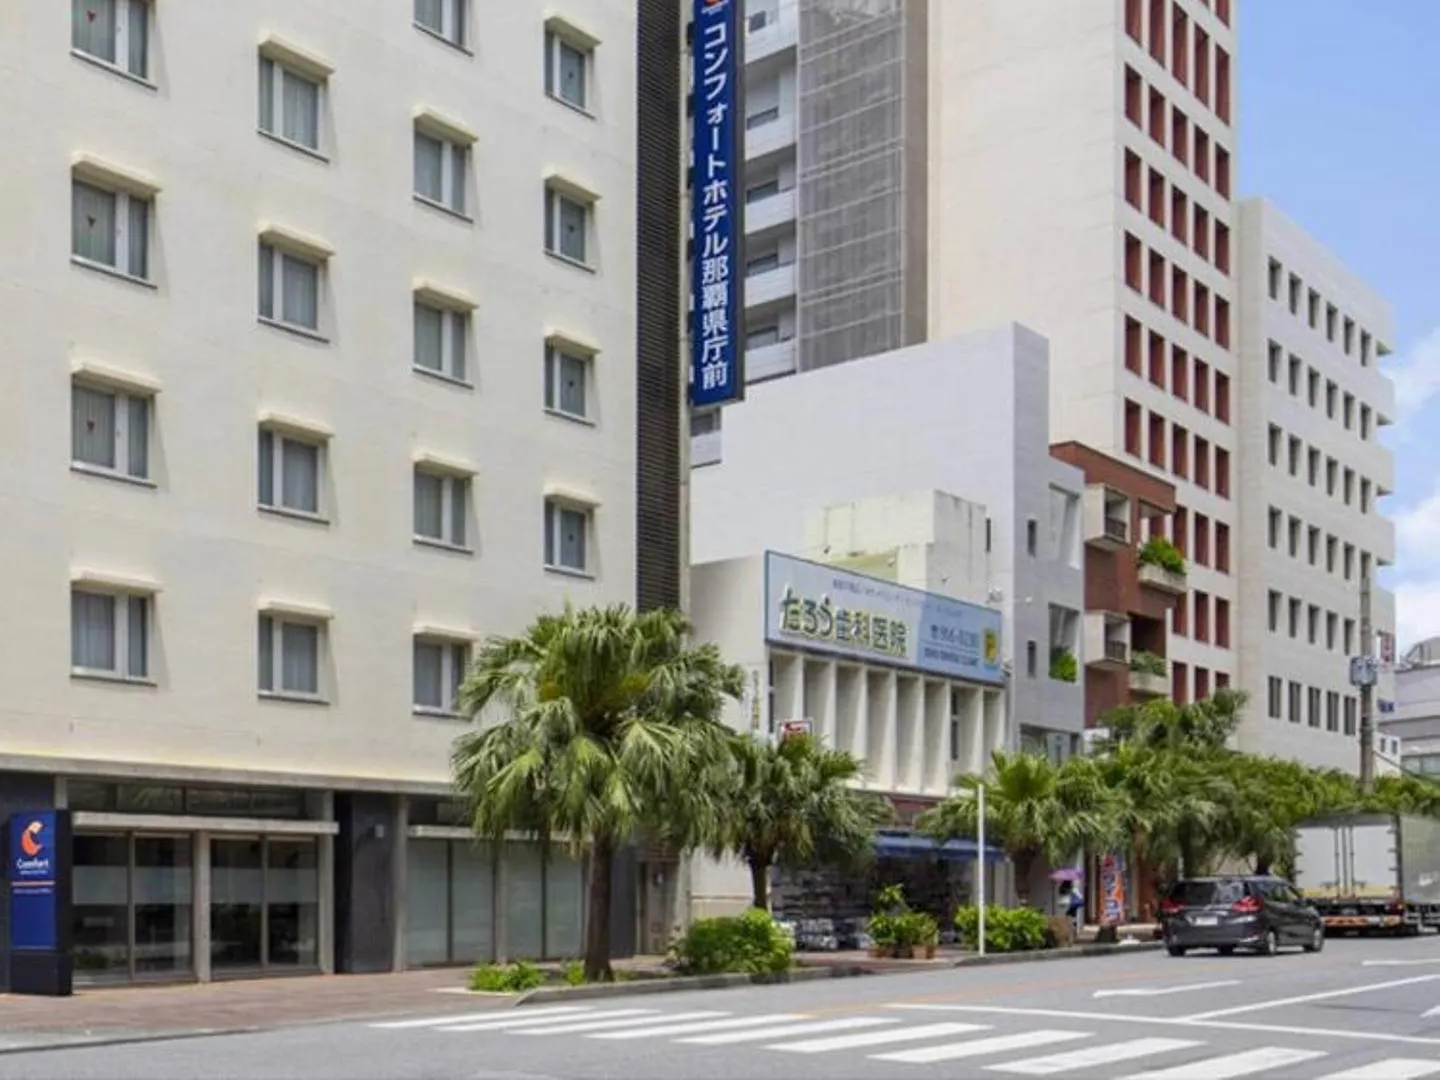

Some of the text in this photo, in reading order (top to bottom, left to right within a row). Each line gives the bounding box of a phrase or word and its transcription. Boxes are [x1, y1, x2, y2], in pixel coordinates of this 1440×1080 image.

[700, 22, 729, 389] コンフォートホテル那覇県庁前
